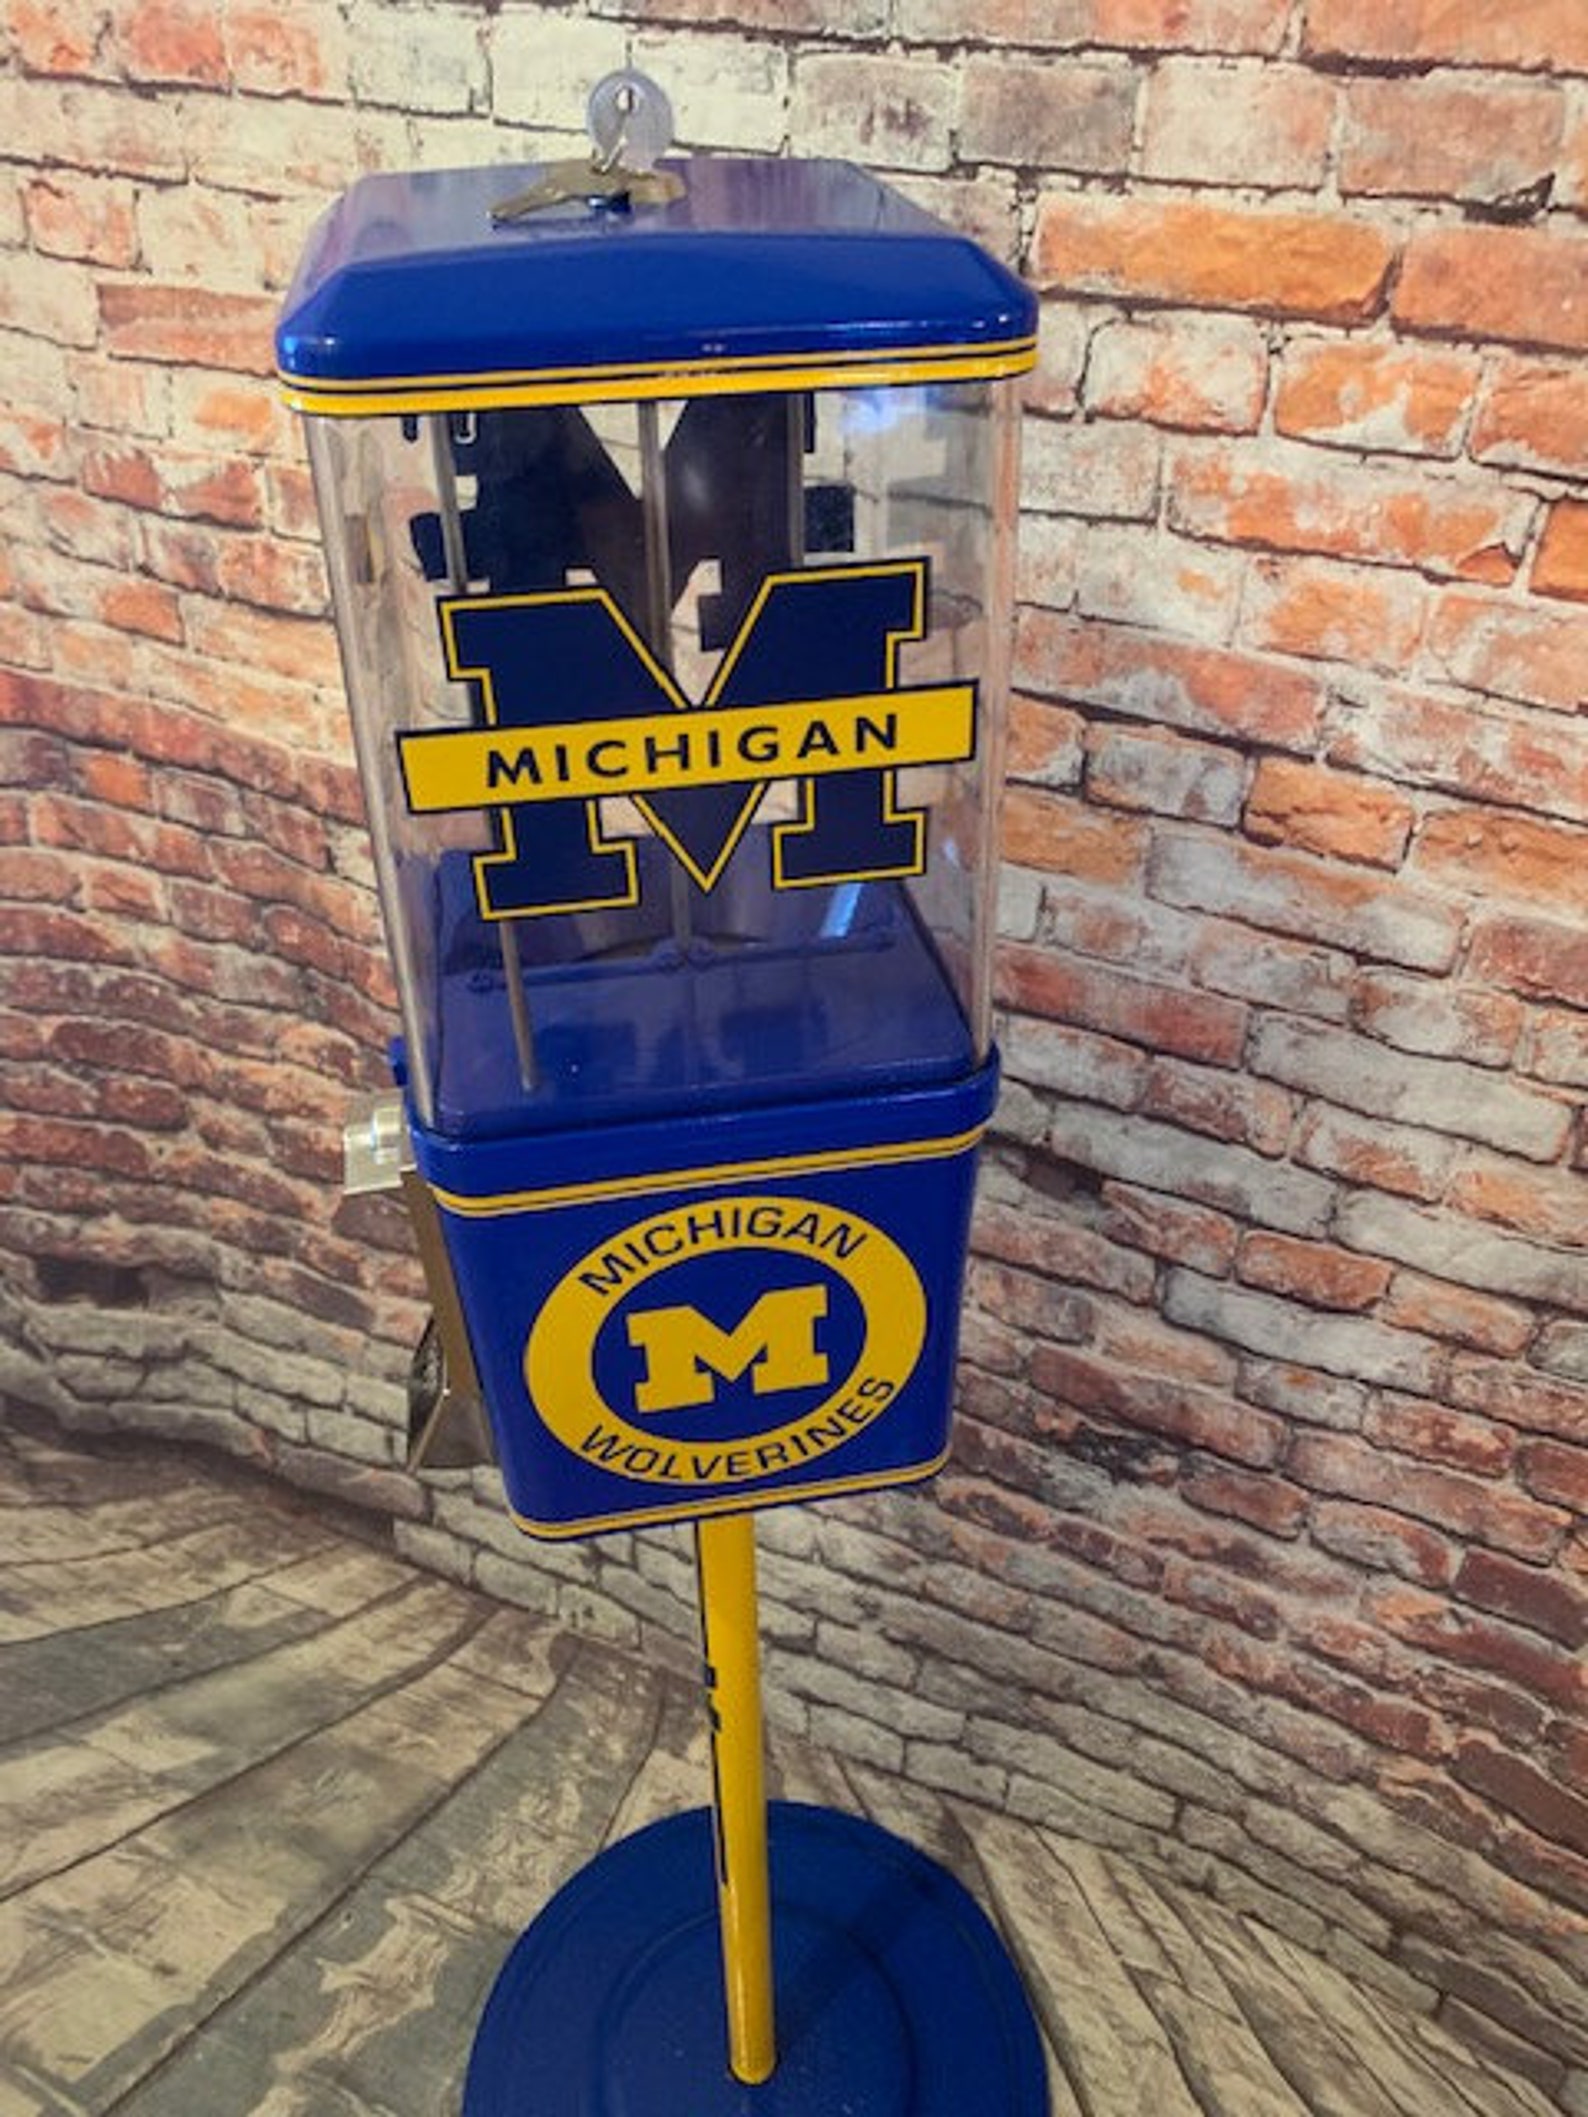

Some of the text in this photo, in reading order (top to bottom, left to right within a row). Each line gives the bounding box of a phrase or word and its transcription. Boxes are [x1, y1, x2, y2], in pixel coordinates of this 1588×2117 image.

[439, 556, 929, 919] M
[486, 713, 898, 789] MICHIGAN
[579, 1206, 867, 1297] MICHIGAN
[627, 1284, 829, 1414] M
[580, 1377, 895, 1479] WOLVERINES
